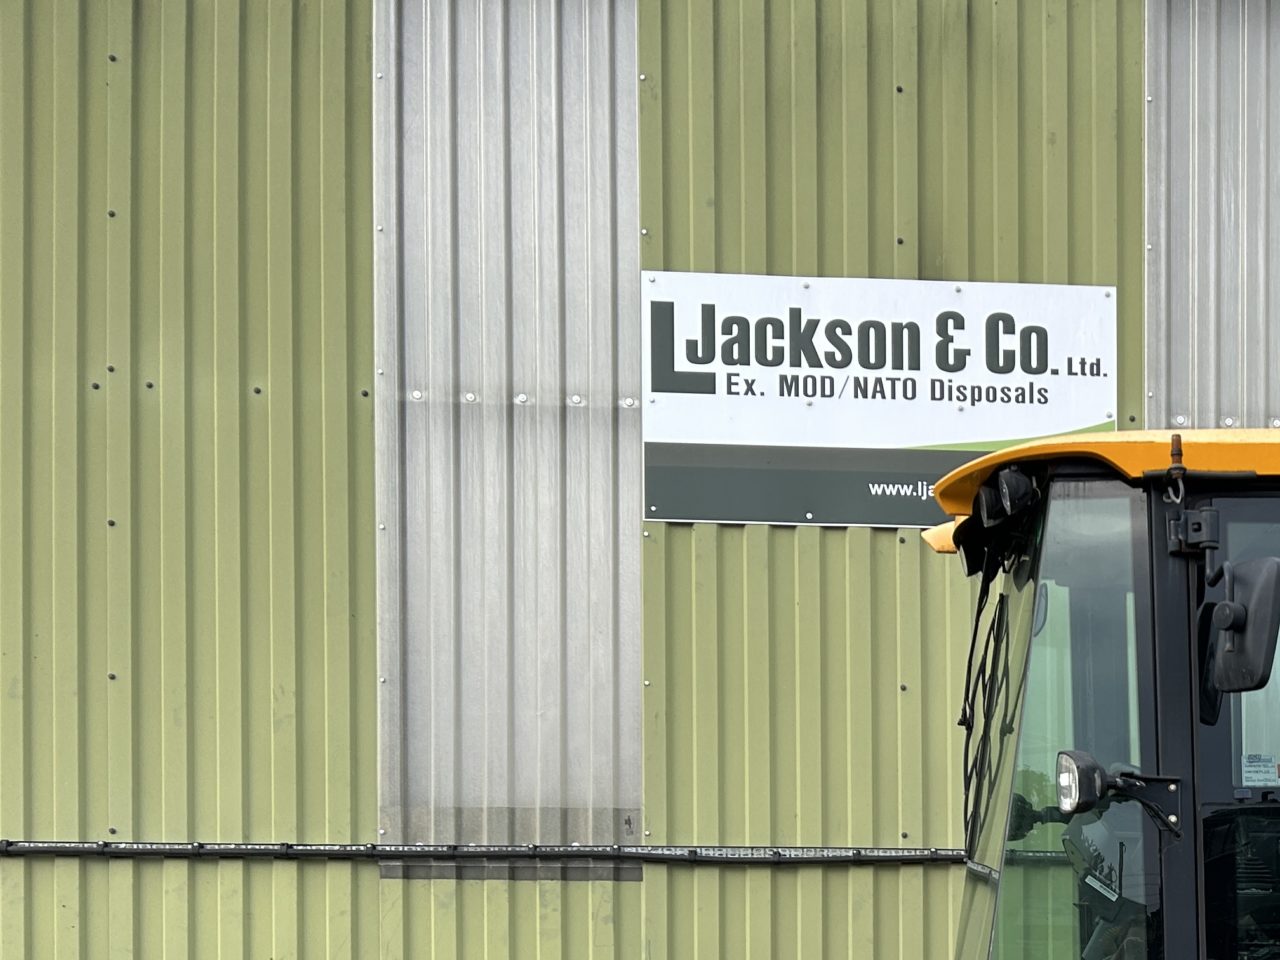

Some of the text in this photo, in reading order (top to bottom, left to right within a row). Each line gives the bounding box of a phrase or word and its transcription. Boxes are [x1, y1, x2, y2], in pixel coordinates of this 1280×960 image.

[935, 310, 971, 373] &
[984, 311, 1059, 375] Co.
[1067, 356, 1108, 378] Ltd.
[726, 372, 1049, 406] Ex. MOD/NATO Disposals
